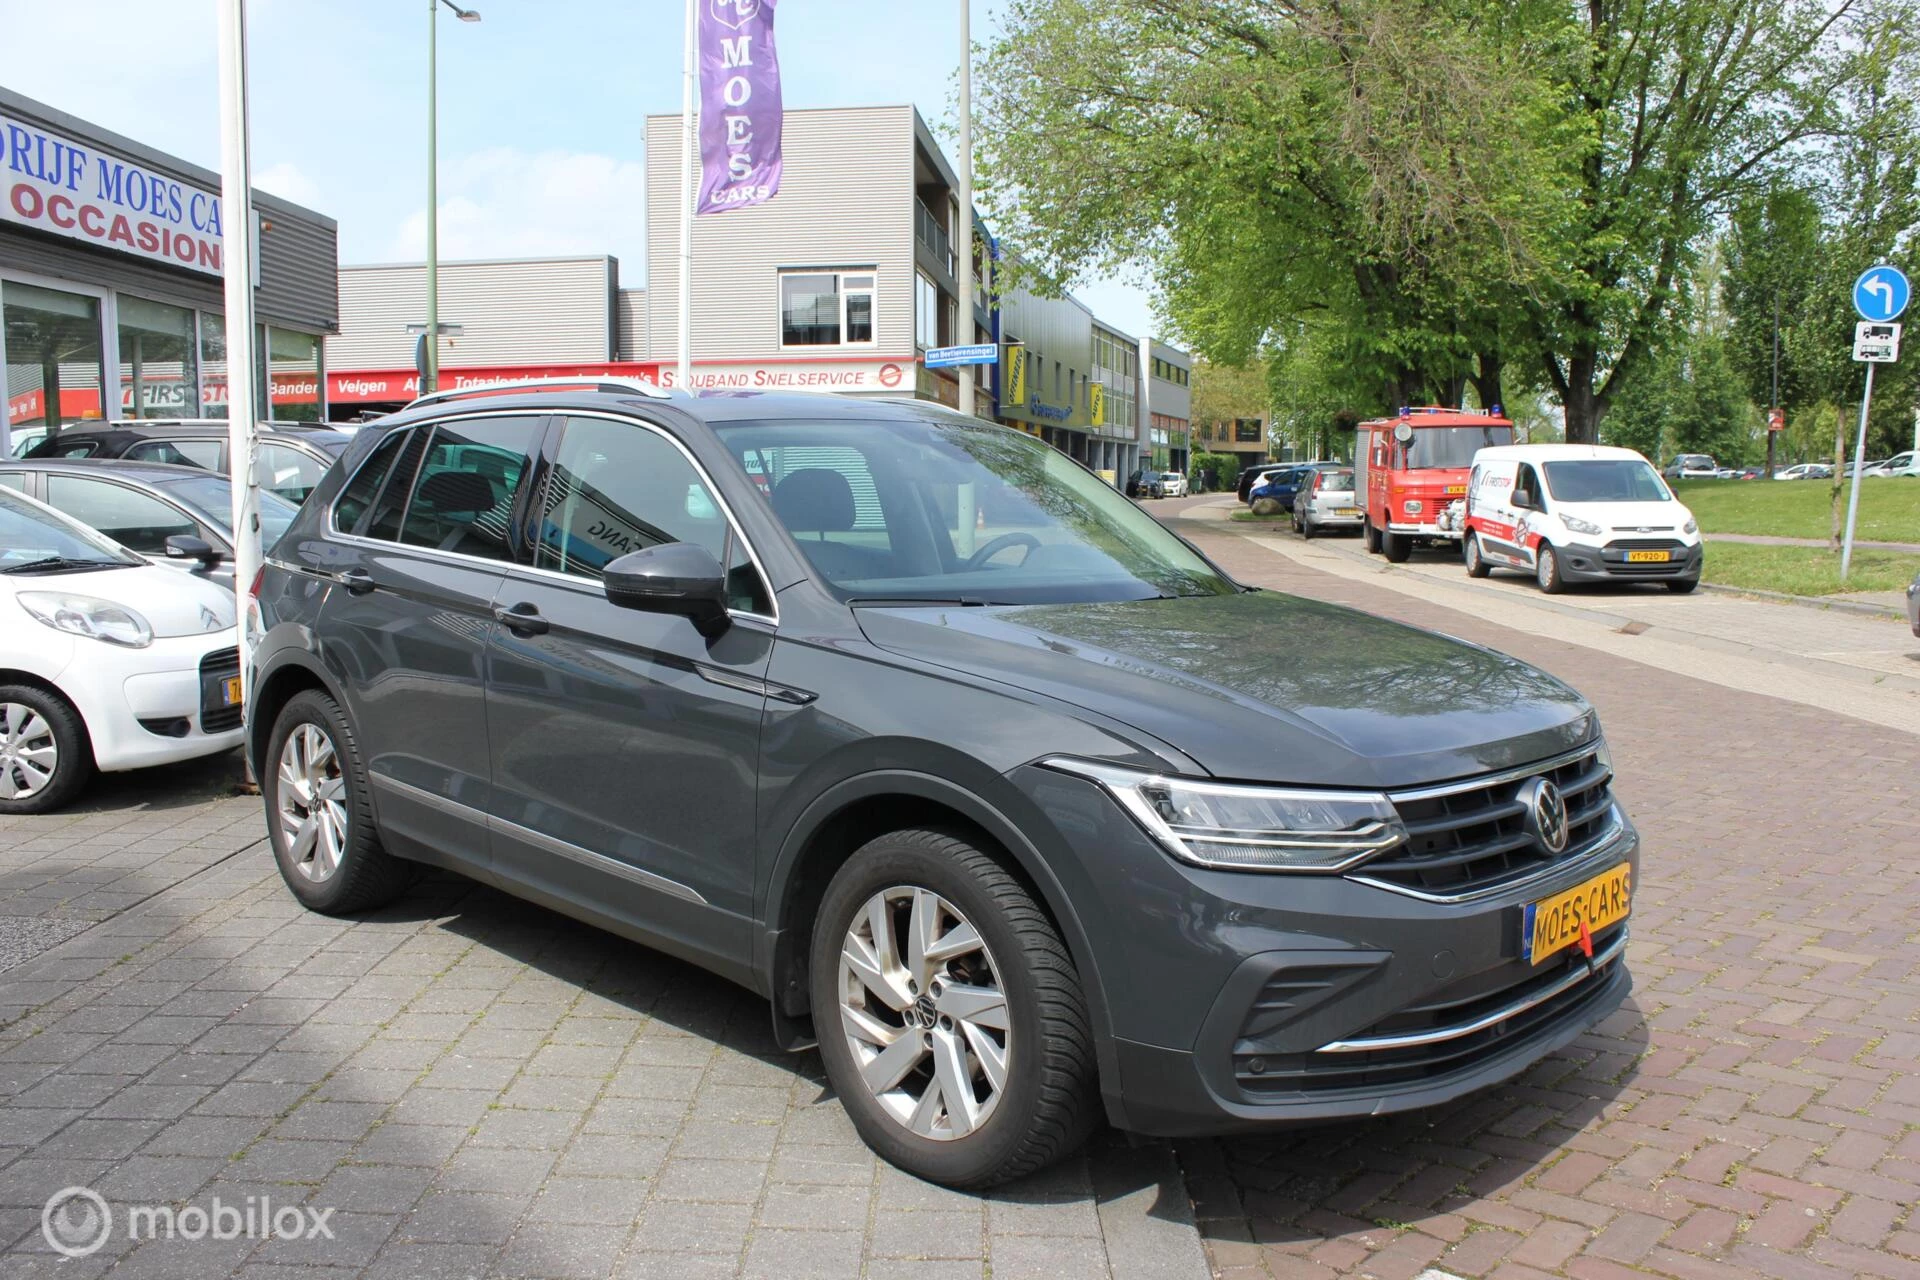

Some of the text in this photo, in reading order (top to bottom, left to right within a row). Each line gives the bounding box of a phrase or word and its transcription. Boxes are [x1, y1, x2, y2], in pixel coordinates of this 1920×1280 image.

[720, 35, 753, 183] MOES
[0, 123, 223, 236] RIJF MOES CA
[711, 185, 770, 204] CARS
[10, 183, 225, 270] OCCASION
[338, 378, 387, 396] Velgen
[754, 370, 864, 386] SNELSERVICE
[1533, 871, 1631, 956] MOES-CARS
